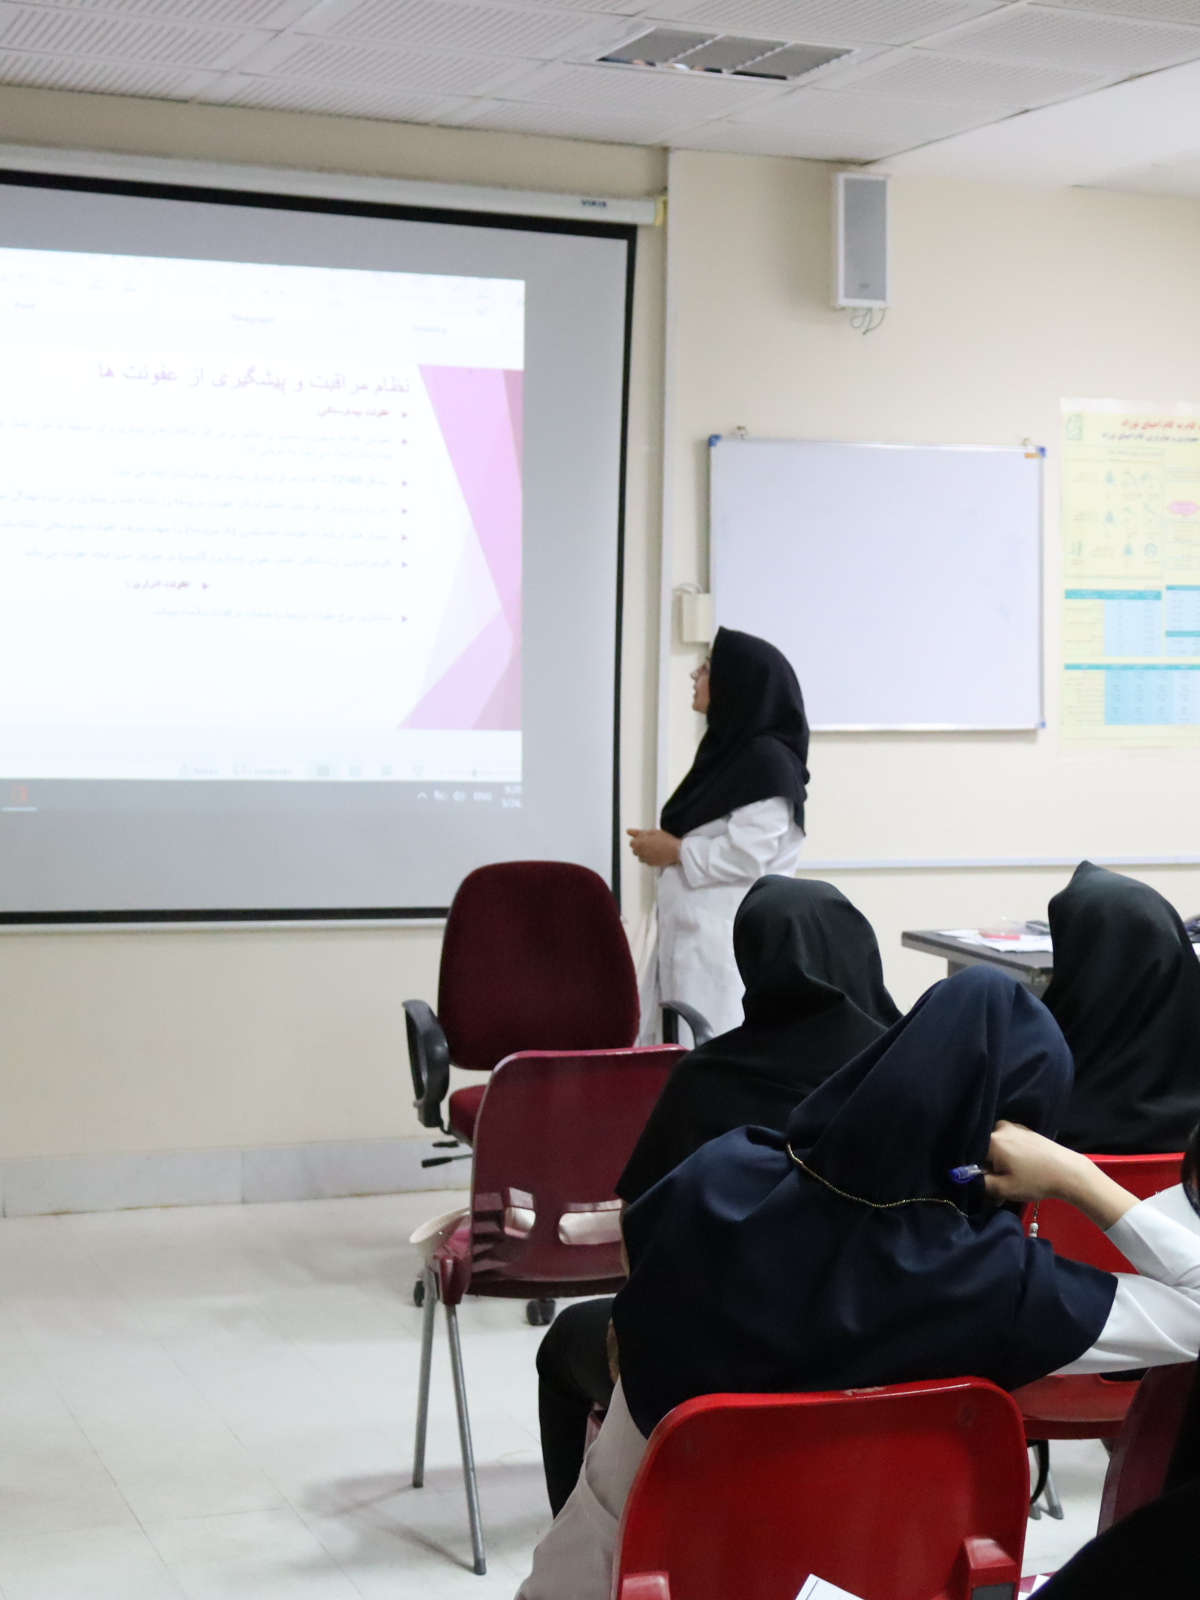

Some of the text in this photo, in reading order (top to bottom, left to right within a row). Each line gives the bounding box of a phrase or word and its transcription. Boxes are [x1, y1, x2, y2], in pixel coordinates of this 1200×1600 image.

[97, 361, 410, 397] نظام مراقبت و پیشگیری از عفونت ها
